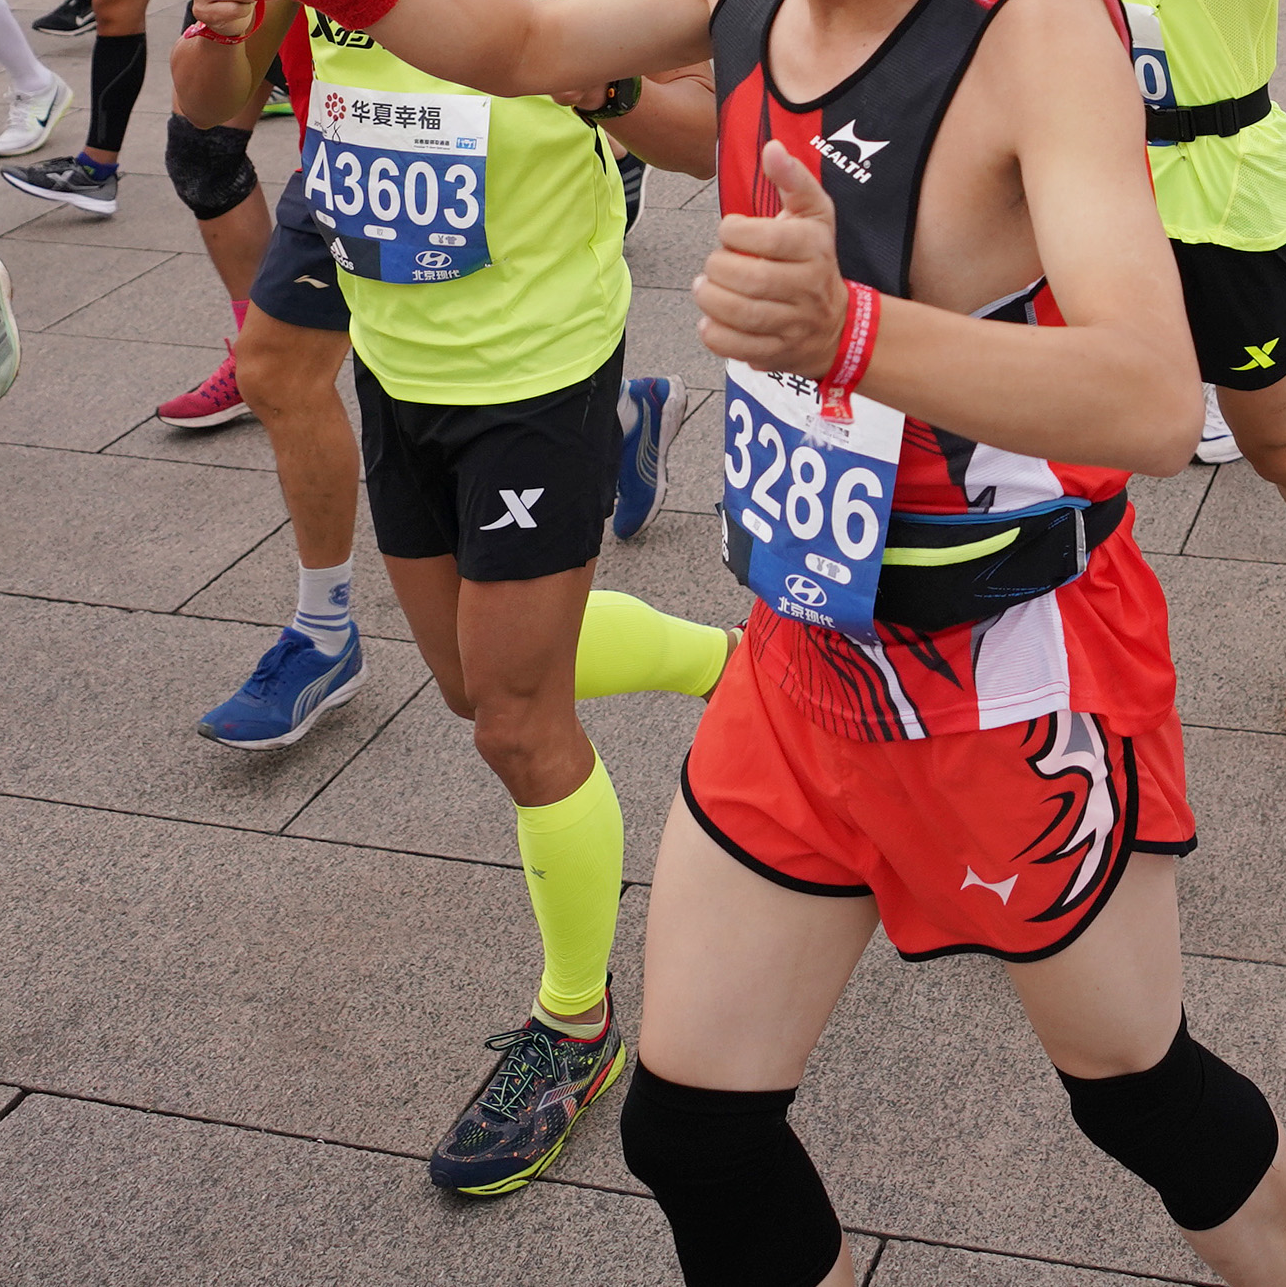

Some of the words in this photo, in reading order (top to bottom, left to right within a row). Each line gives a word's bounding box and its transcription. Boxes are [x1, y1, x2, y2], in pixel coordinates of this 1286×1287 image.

[351, 99, 442, 130] 华夏幸福
[809, 134, 872, 184] HEALTH
[304, 140, 480, 230] A3603
[412, 269, 461, 282] 北京现代
[724, 398, 883, 561] 3286
[778, 595, 835, 630] 北京现代
